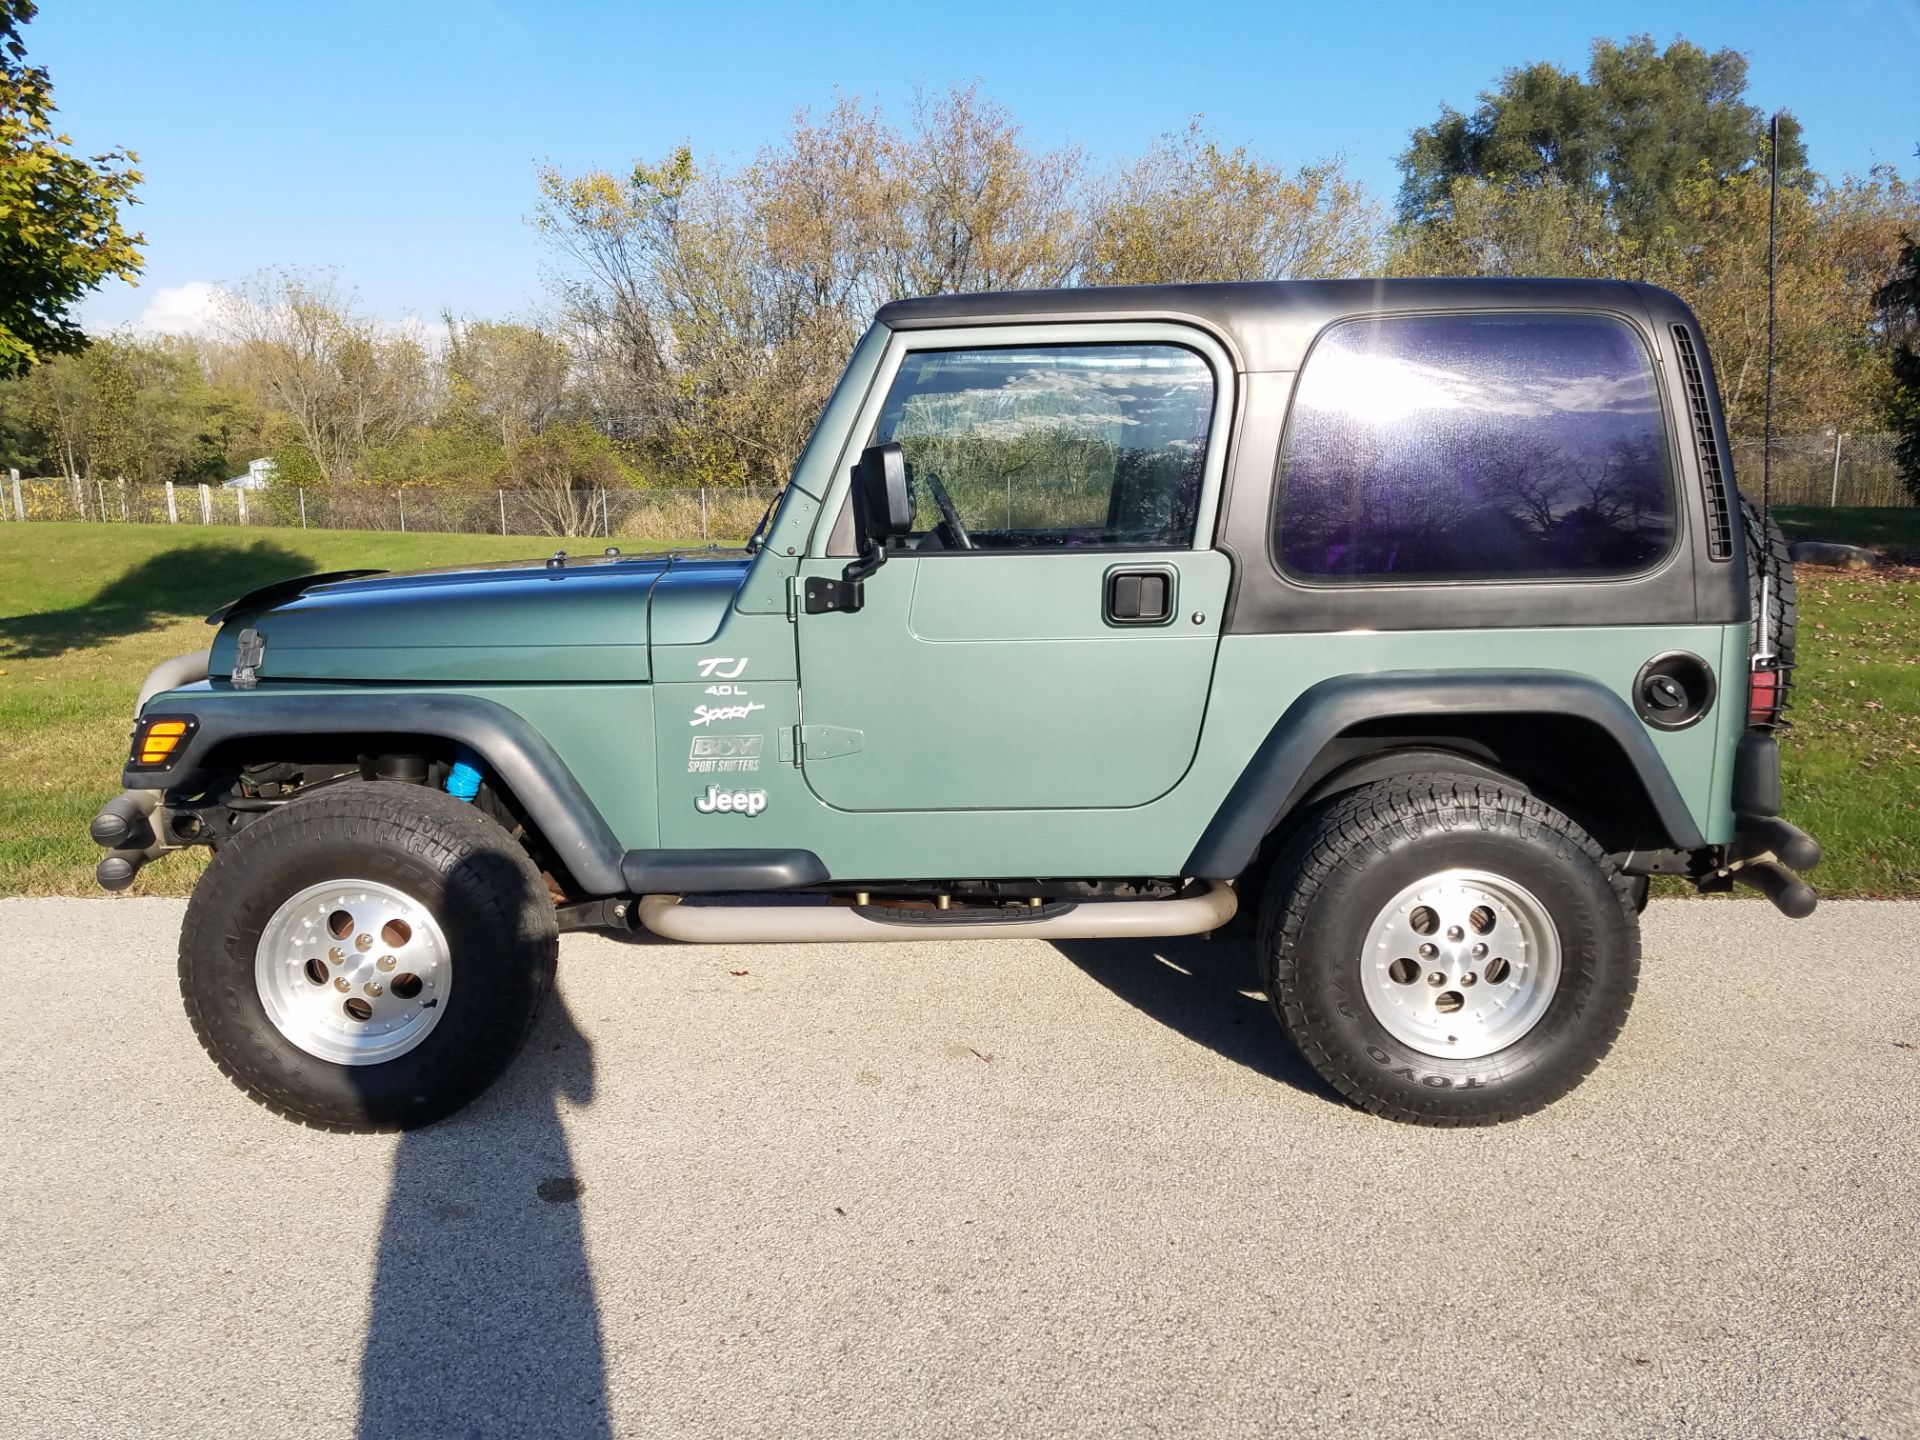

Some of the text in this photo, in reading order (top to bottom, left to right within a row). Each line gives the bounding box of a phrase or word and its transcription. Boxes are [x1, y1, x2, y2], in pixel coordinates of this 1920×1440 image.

[697, 657, 749, 679] TJ
[688, 701, 766, 726] Sport
[687, 759, 760, 773] SPORT SHIFTERS
[696, 786, 767, 815] Jeep
[1366, 1044, 1488, 1093] TOYO
